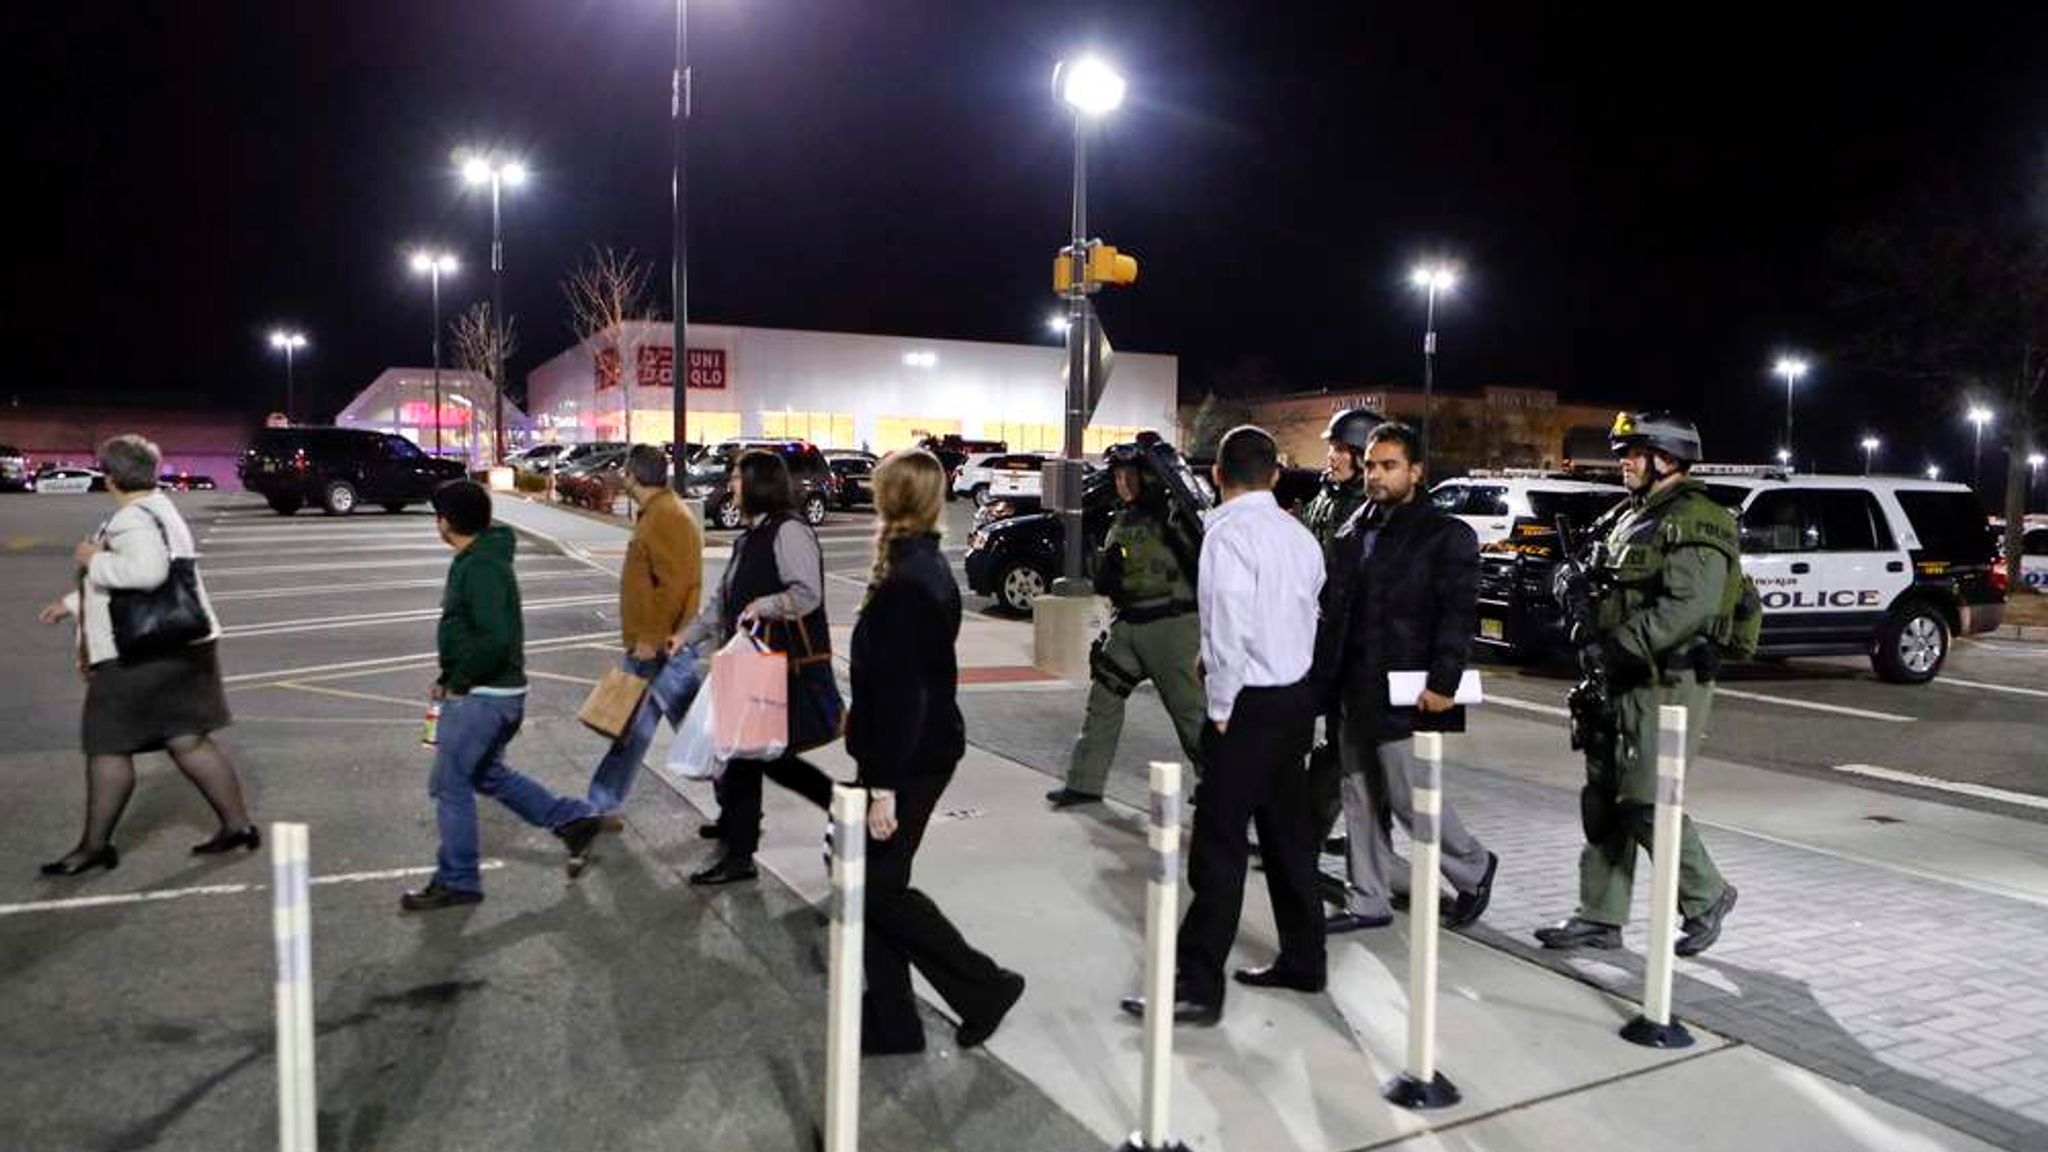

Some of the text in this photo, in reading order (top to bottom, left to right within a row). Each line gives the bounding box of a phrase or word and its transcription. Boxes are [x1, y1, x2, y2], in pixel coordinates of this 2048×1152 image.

[690, 352, 720, 368] UNI
[690, 370, 723, 386] QLO
[1762, 590, 1880, 608] OLICE
